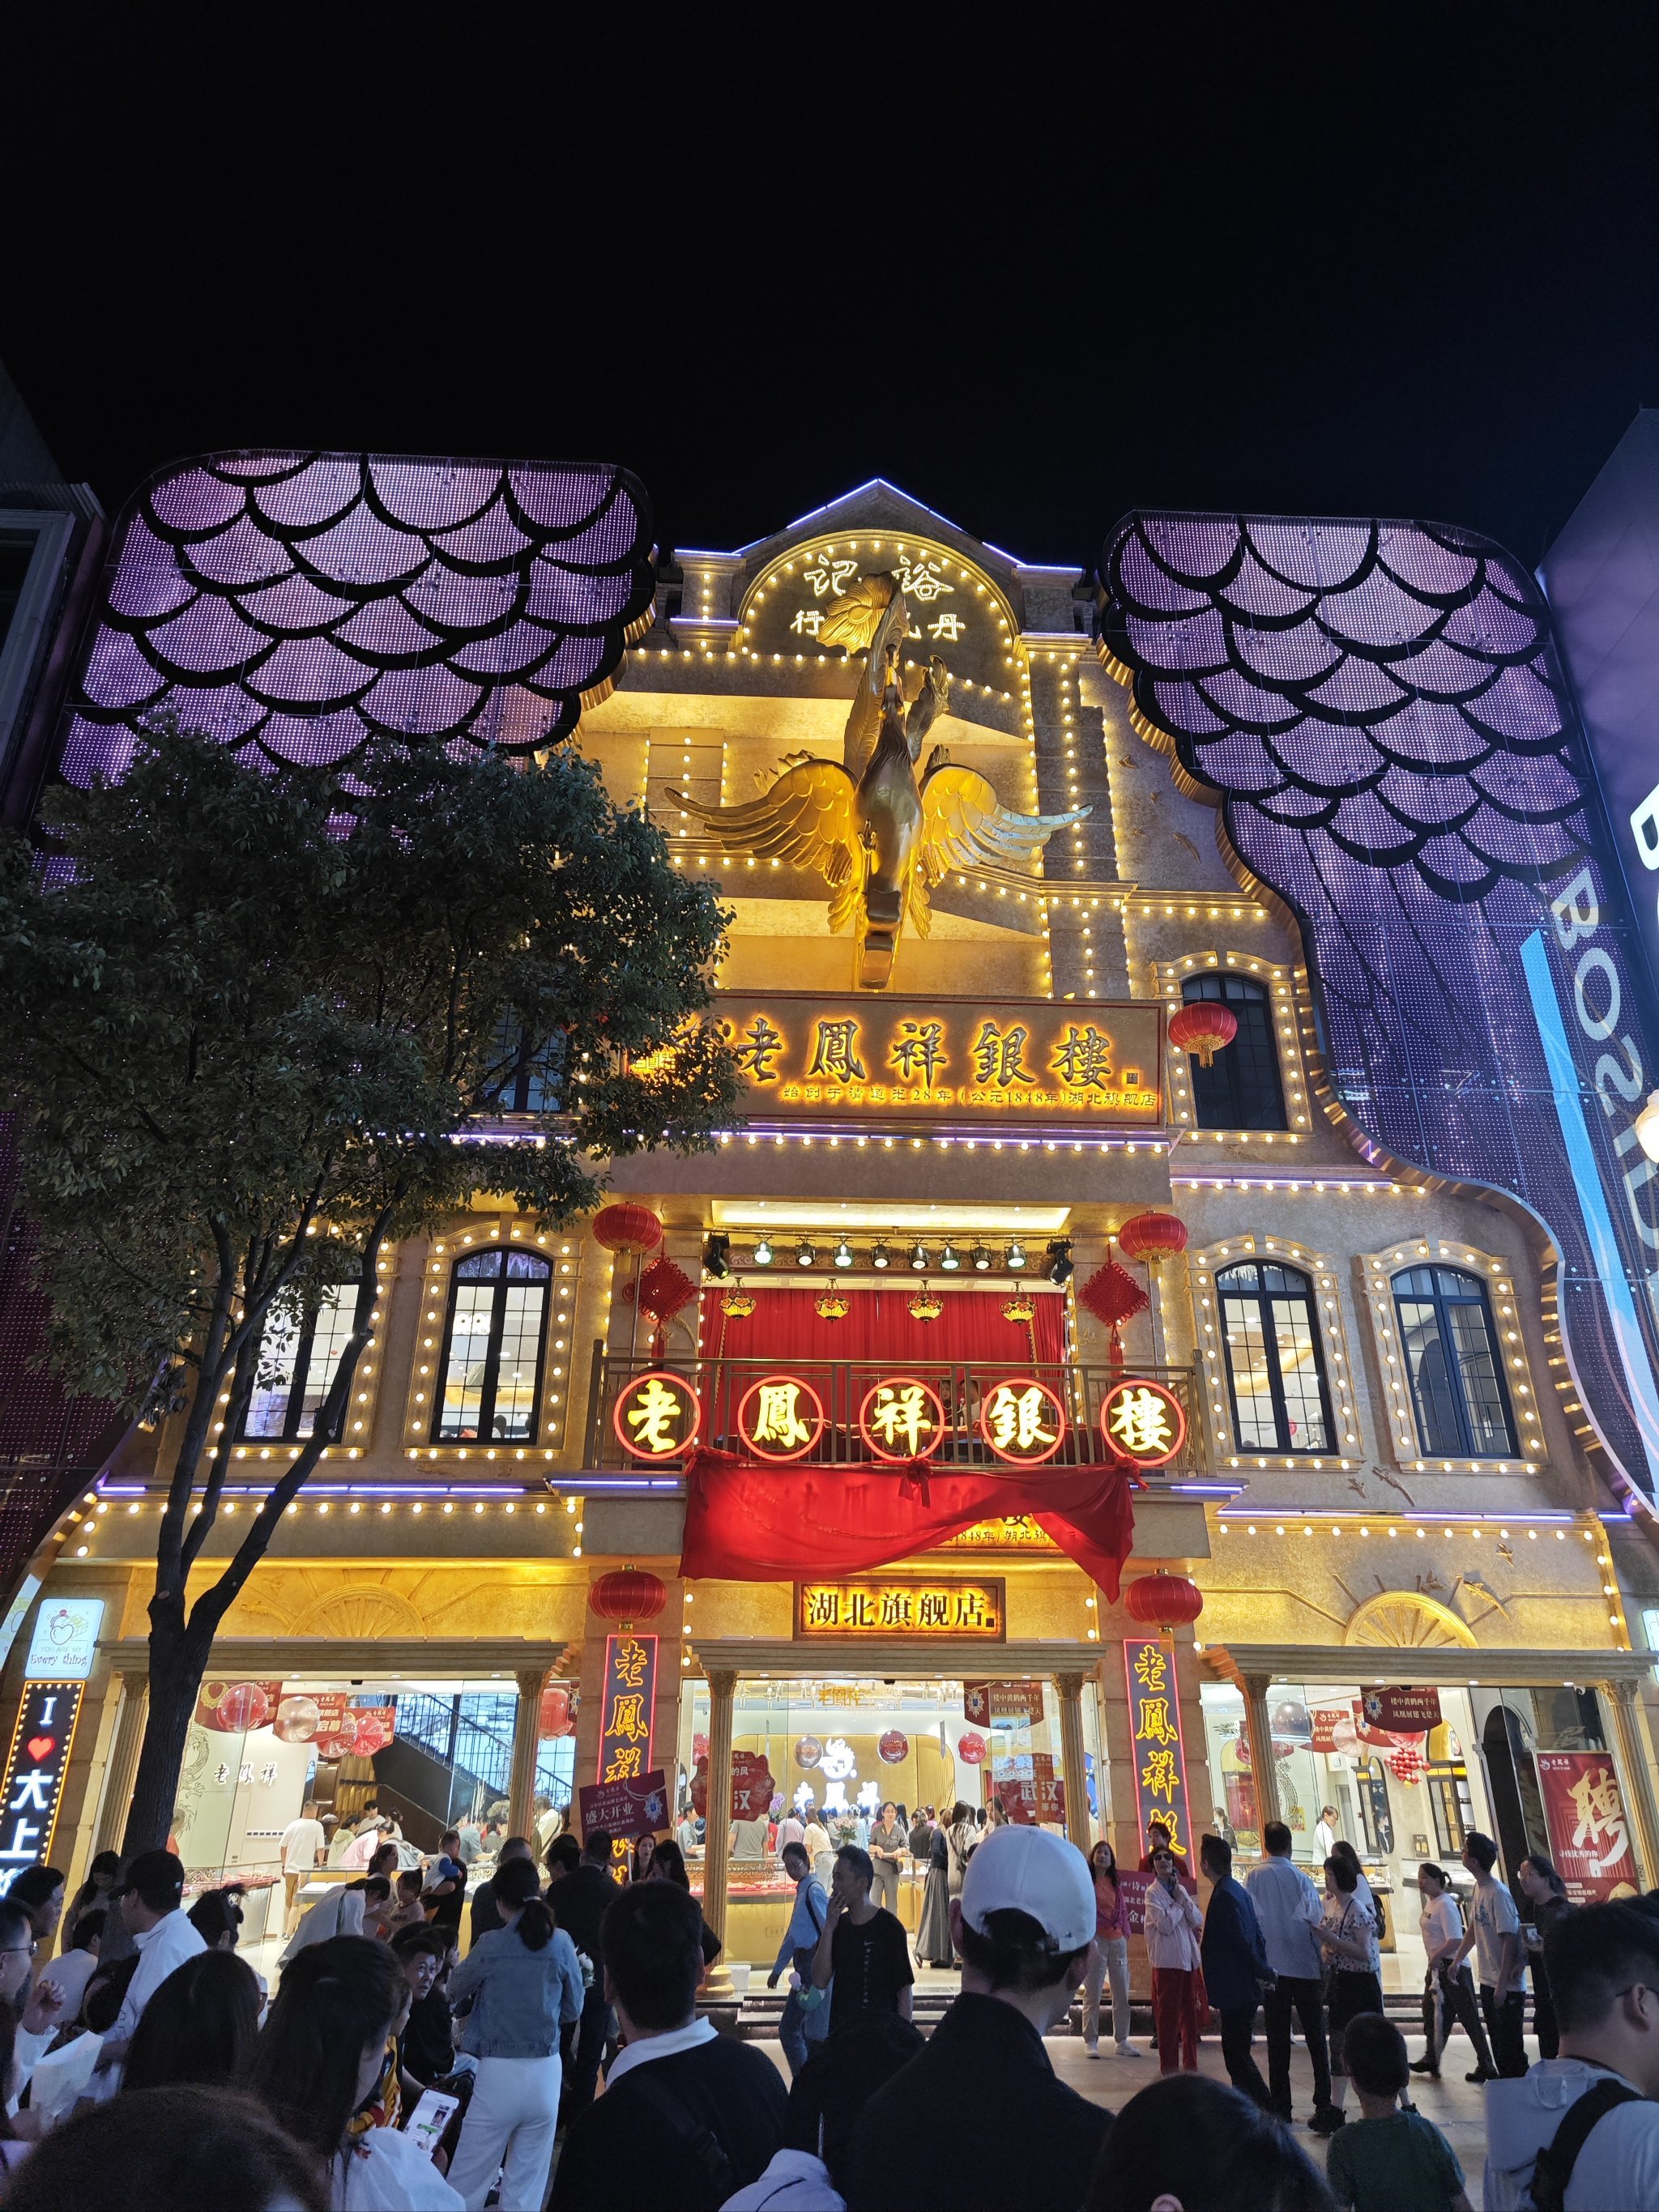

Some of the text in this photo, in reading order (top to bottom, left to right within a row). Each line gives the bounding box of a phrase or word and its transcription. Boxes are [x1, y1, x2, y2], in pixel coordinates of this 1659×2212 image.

[737, 1017, 1113, 1090] 老鳳祥銀樓
[627, 1379, 1174, 1456] 老鳳祥銀樓
[807, 1584, 987, 1629] 湖北旗舰店
[31, 1654, 58, 1666] Every
[1020, 1781, 1058, 1801] 武汉
[586, 1802, 634, 1825] 盛大开业
